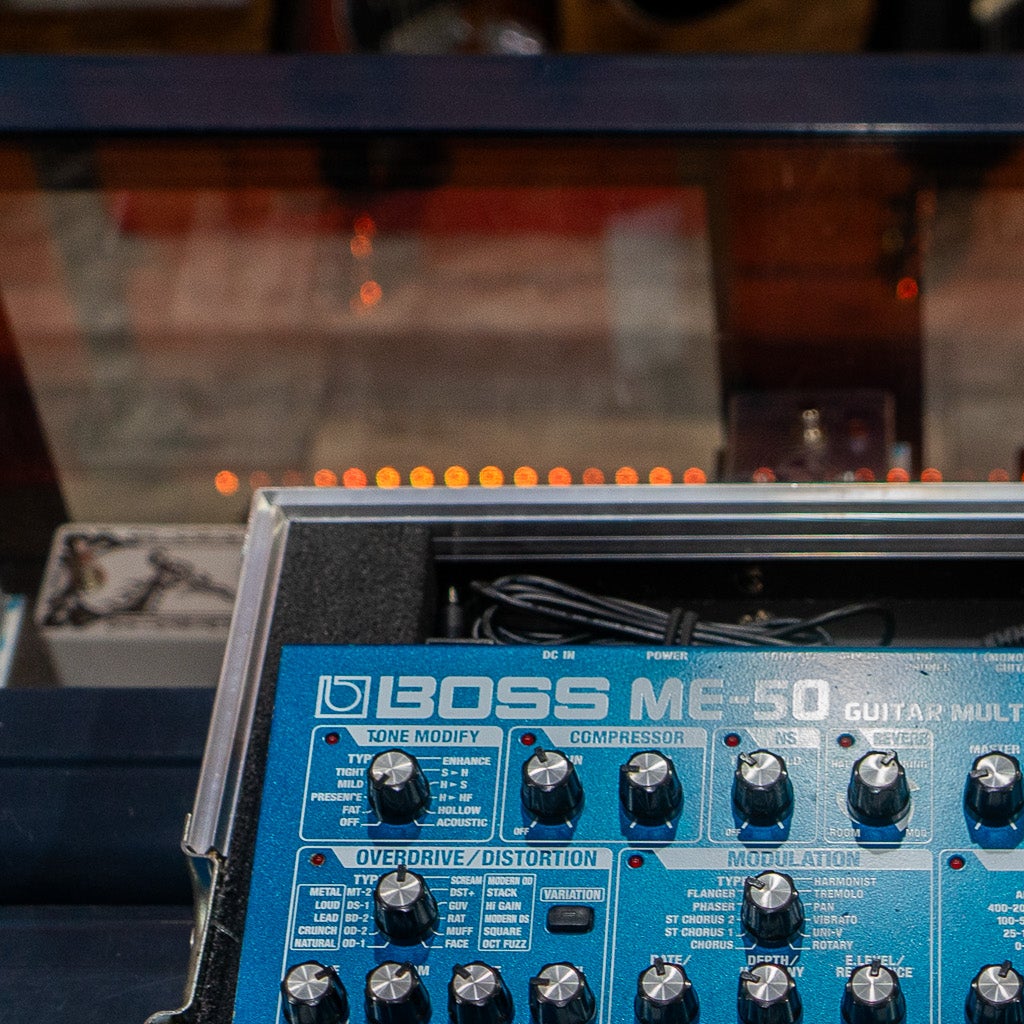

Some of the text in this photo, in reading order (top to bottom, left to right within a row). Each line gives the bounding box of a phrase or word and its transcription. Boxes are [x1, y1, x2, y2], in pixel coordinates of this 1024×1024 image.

[543, 651, 575, 660] DC IN
[646, 651, 688, 661] POWER
[376, 676, 610, 719] BOSS
[630, 677, 830, 721] ME-50
[844, 702, 942, 722] GUITAR
[367, 730, 479, 743] TONE MODIFY
[570, 731, 685, 744] COMPRESSOR
[348, 754, 375, 764] TYP
[442, 756, 491, 765] ENHANCE
[336, 768, 364, 777] TIGHT
[338, 780, 363, 789] MILD
[311, 793, 362, 802] PRESENCE
[343, 805, 361, 814] FAT
[438, 805, 481, 815] HOLLOW
[340, 818, 360, 827] OFF
[436, 818, 488, 828] ACOUSTIC
[356, 849, 597, 866] OVERDRIVE/DISTORTION
[728, 851, 860, 867] MODULATION
[354, 874, 380, 885] TYP
[450, 876, 482, 885] SCREAM
[488, 876, 532, 885] MODERN OD
[814, 877, 877, 886] HARMONIST
[310, 888, 372, 897] METAL MT-2
[450, 888, 475, 897] DST+
[486, 888, 517, 897] STACK
[544, 889, 601, 900] VARIATION
[687, 889, 735, 898] FLANGER
[814, 889, 864, 899] TREMOLO
[315, 901, 369, 910] LOUD DS-1
[449, 901, 468, 911] GUV
[498, 901, 521, 910] GAIN
[693, 902, 735, 911] PHASER
[813, 902, 834, 911] PAN
[314, 914, 369, 922] LEAD BD-2
[447, 914, 465, 923] RAT
[484, 914, 517, 923] MODERN
[665, 915, 734, 924] ST CHORUS 2
[813, 915, 857, 924] VIBRATO
[298, 926, 368, 935] CRUNCH OD-2
[446, 926, 473, 936] MUFF
[483, 927, 521, 936] SQUARE
[665, 928, 722, 937] ST CHORUS
[813, 928, 842, 937] UNI-V
[294, 939, 365, 948] NATURAL OD-1
[445, 939, 468, 948] FACE
[482, 939, 527, 948] OCT FUZZ
[691, 940, 734, 950] CHORUS
[813, 941, 853, 950] ROTARY
